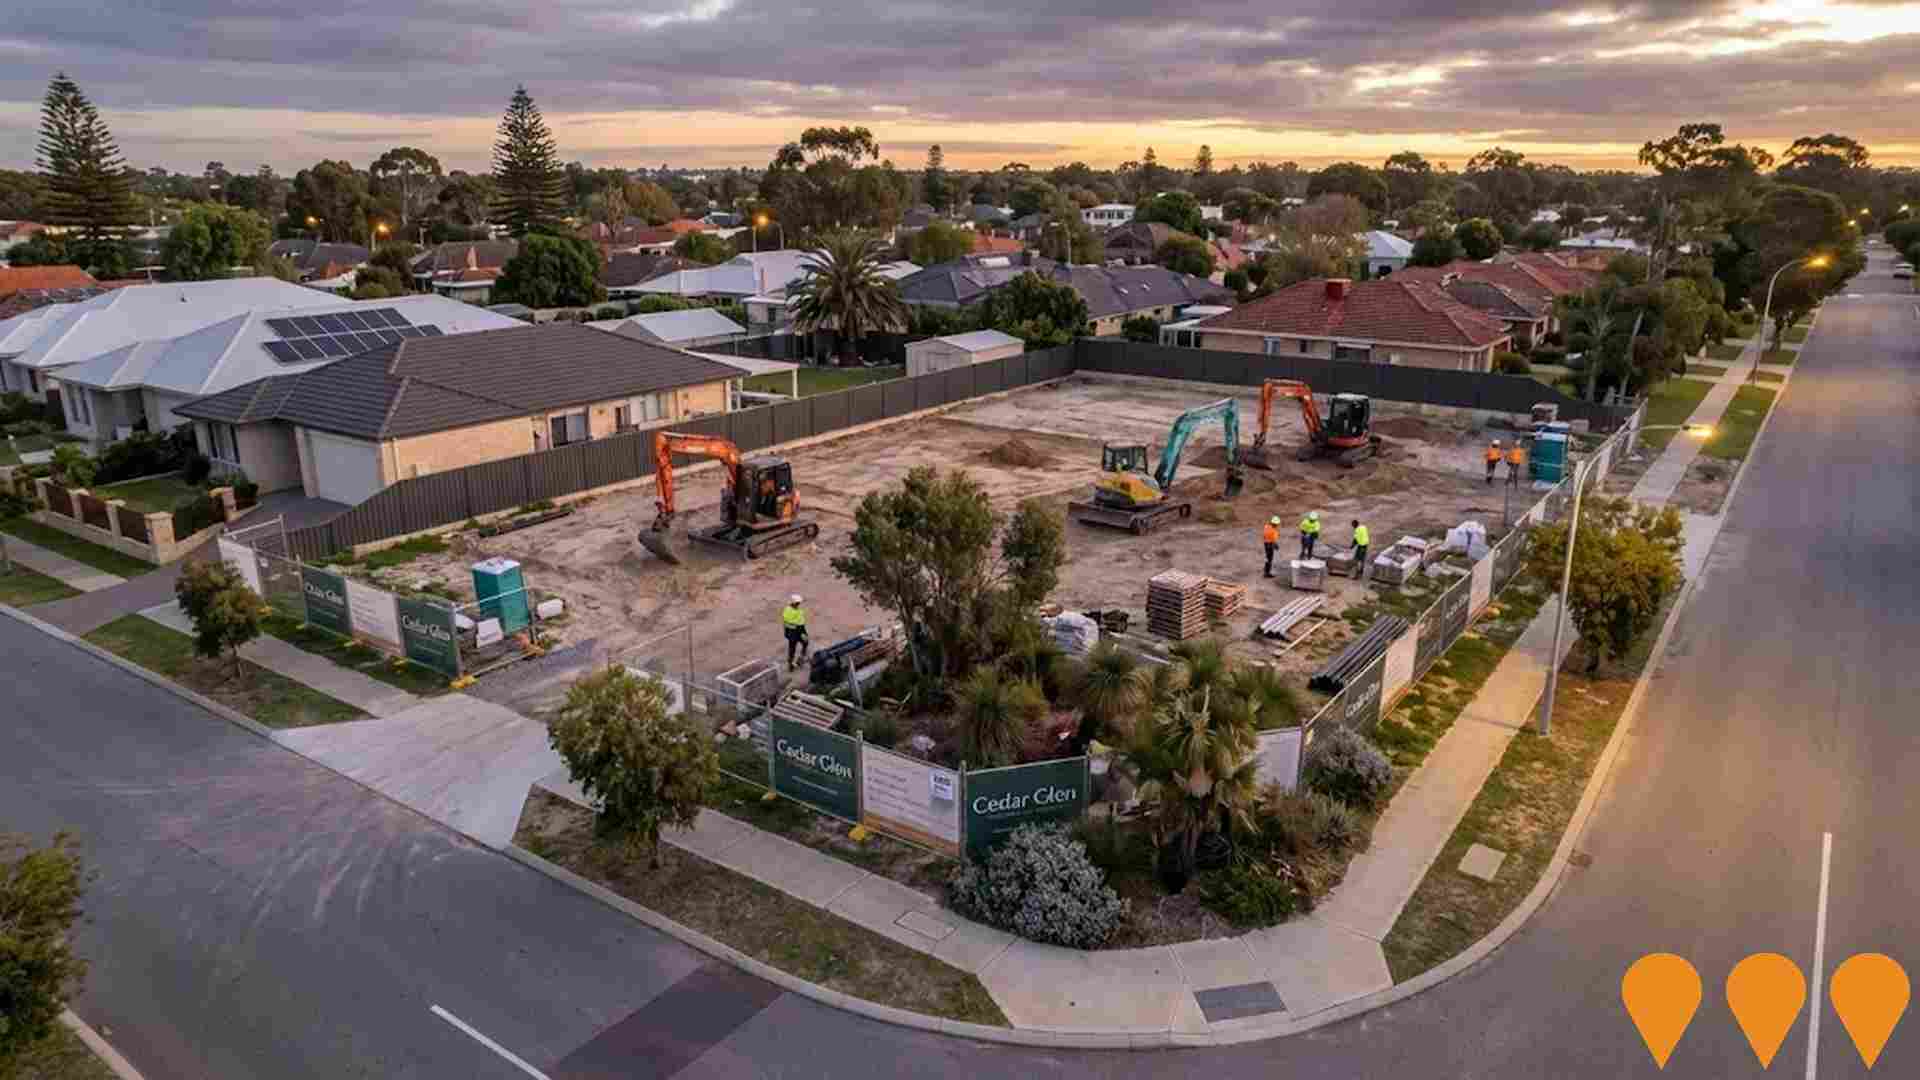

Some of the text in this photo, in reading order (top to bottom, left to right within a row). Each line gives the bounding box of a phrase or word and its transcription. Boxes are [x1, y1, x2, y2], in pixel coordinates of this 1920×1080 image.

[776, 738, 854, 779] Cedar Glen
[973, 785, 1077, 815] Cedar Glen
